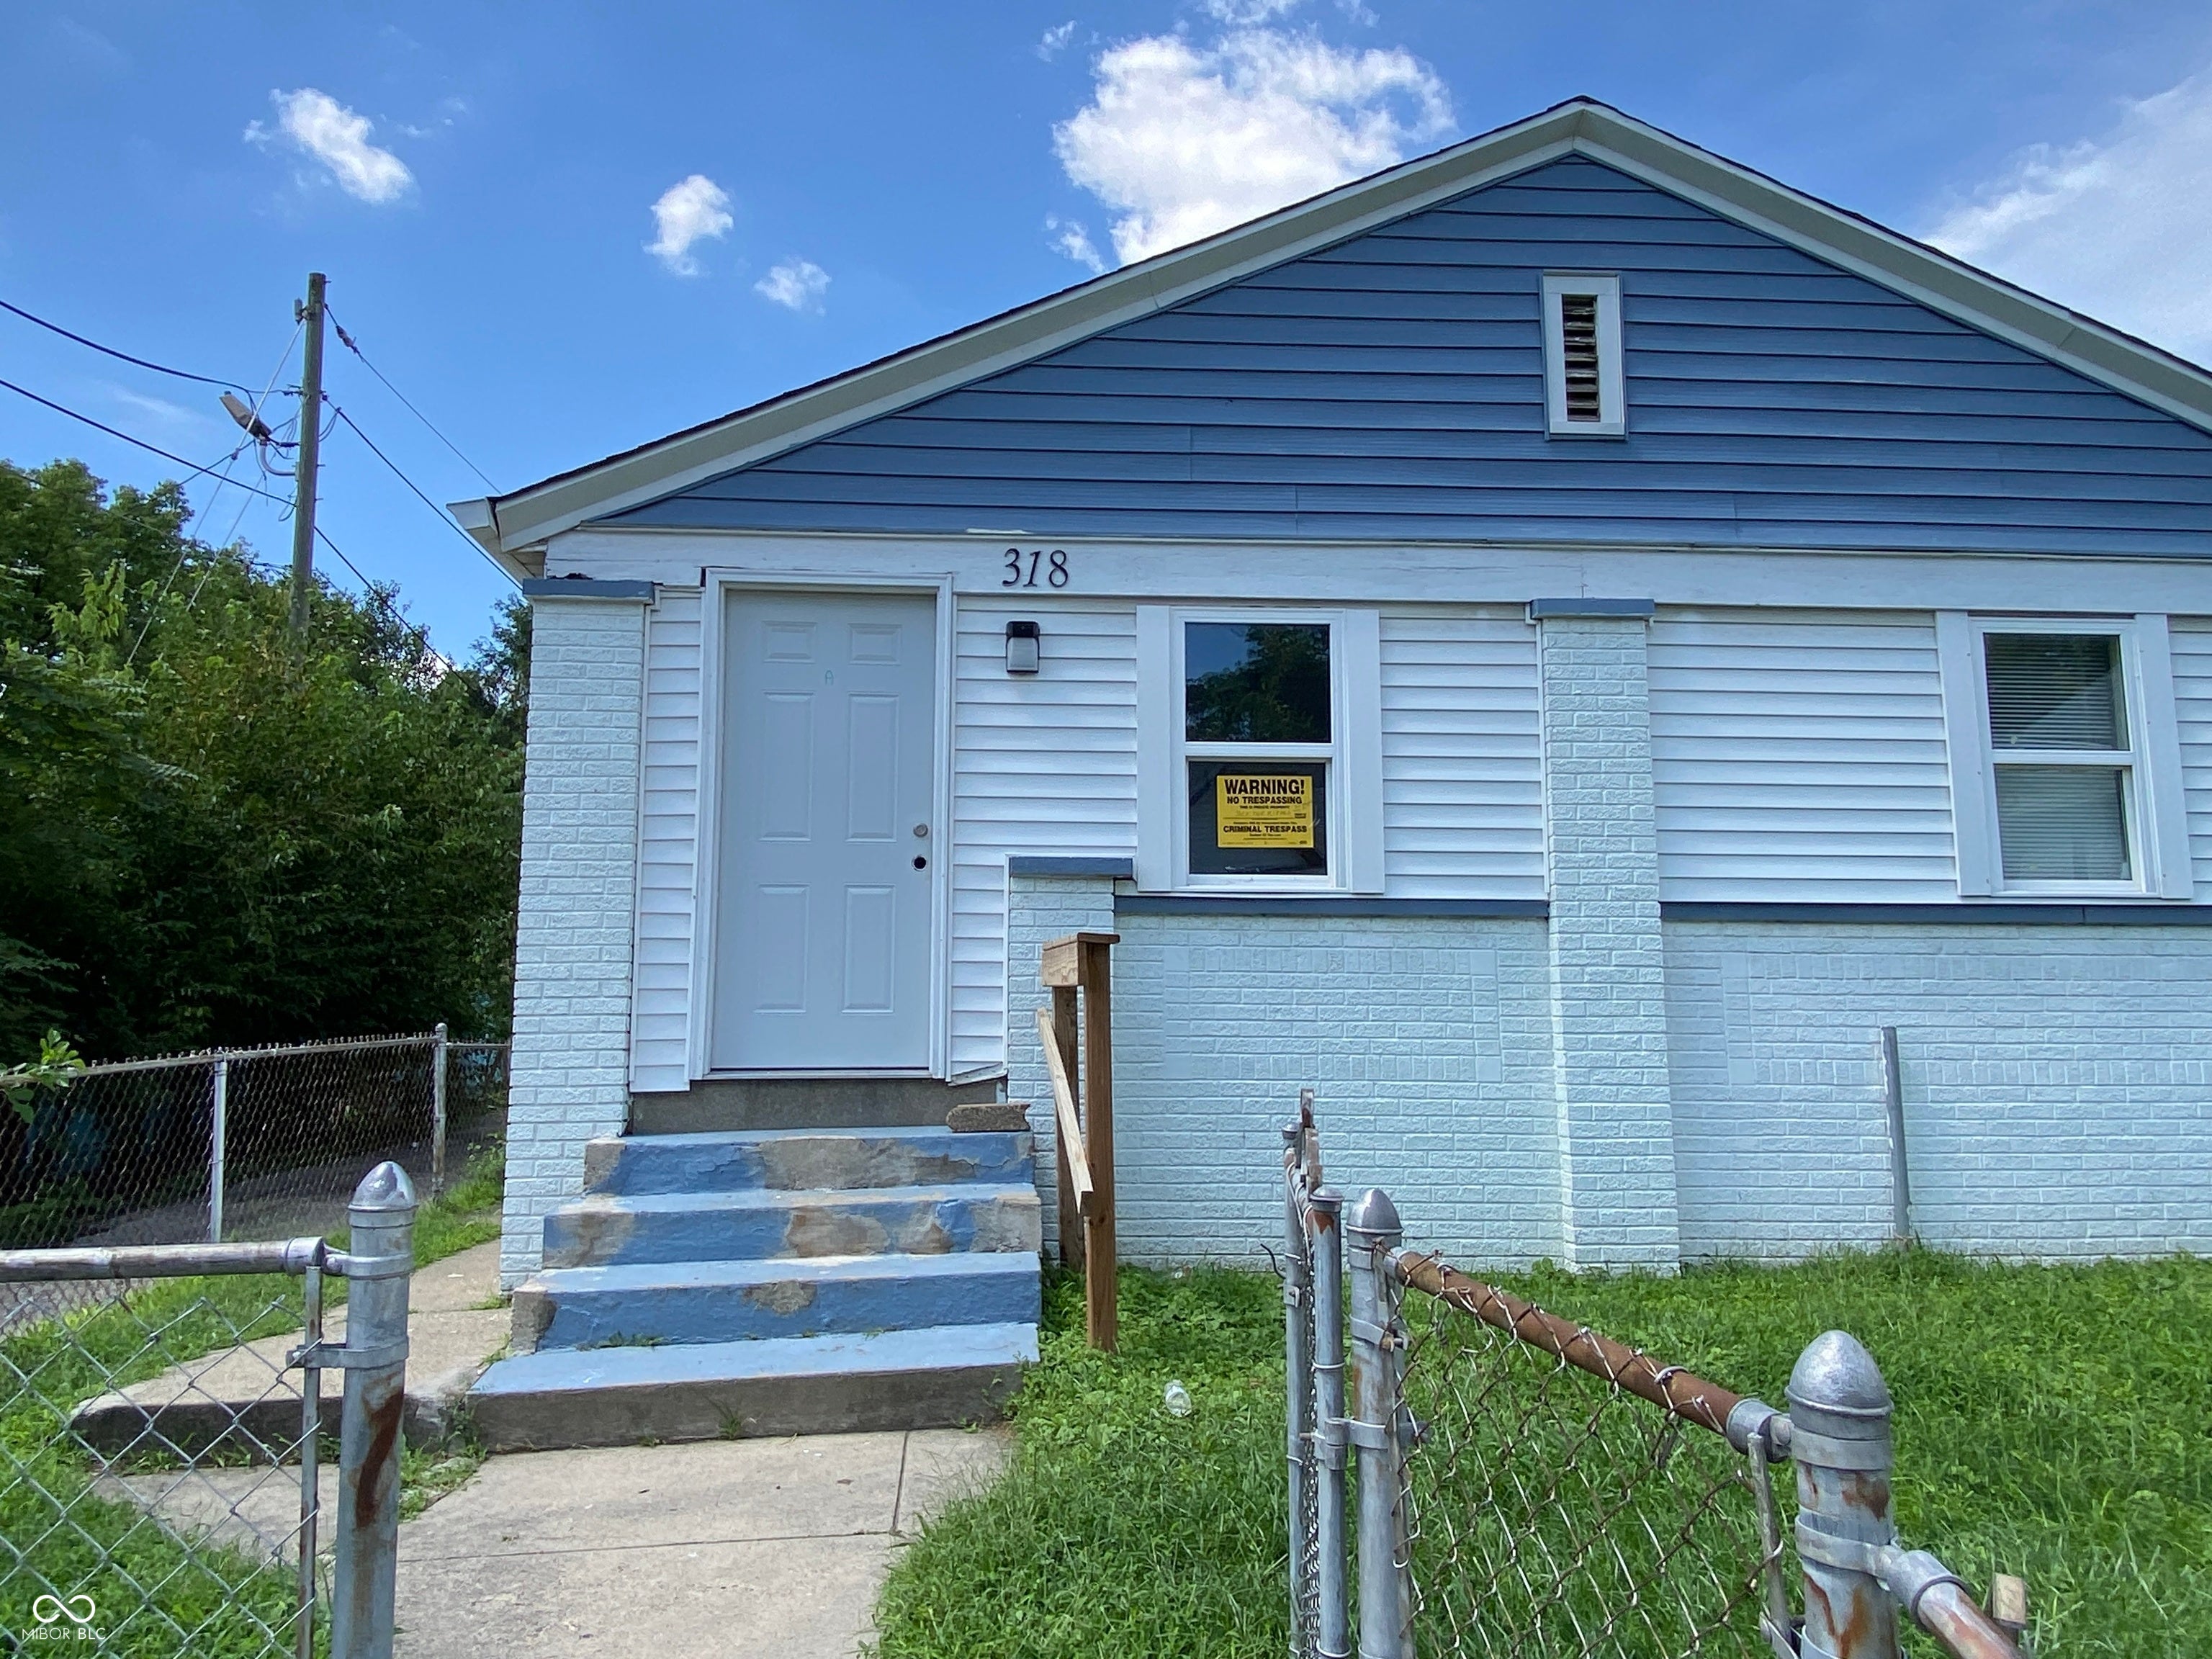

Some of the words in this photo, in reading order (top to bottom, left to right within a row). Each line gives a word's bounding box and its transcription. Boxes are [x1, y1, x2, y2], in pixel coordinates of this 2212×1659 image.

[1002, 548, 1069, 588] 318
[824, 670, 834, 685] A
[1224, 779, 1305, 795] WARNING!
